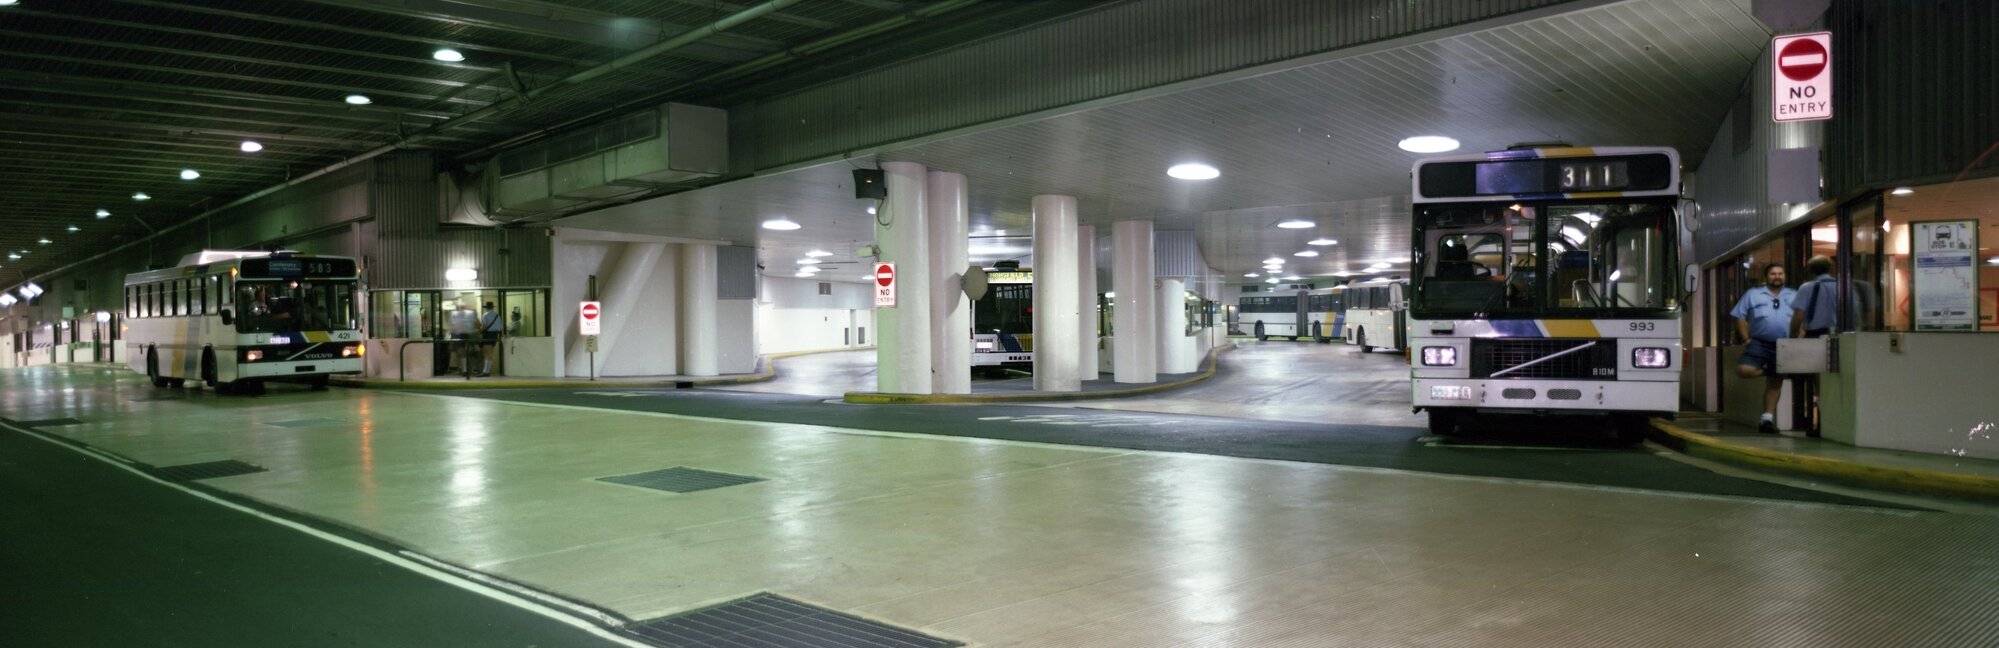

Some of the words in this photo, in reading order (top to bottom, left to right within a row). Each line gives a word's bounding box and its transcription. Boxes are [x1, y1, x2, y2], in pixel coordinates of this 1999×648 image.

[1790, 85, 1816, 99] NO
[1780, 101, 1826, 115] ENTRY
[1563, 165, 1610, 187] 311
[309, 263, 331, 273] 583
[1629, 322, 1655, 332] 993
[1592, 367, 1615, 376] B10M
